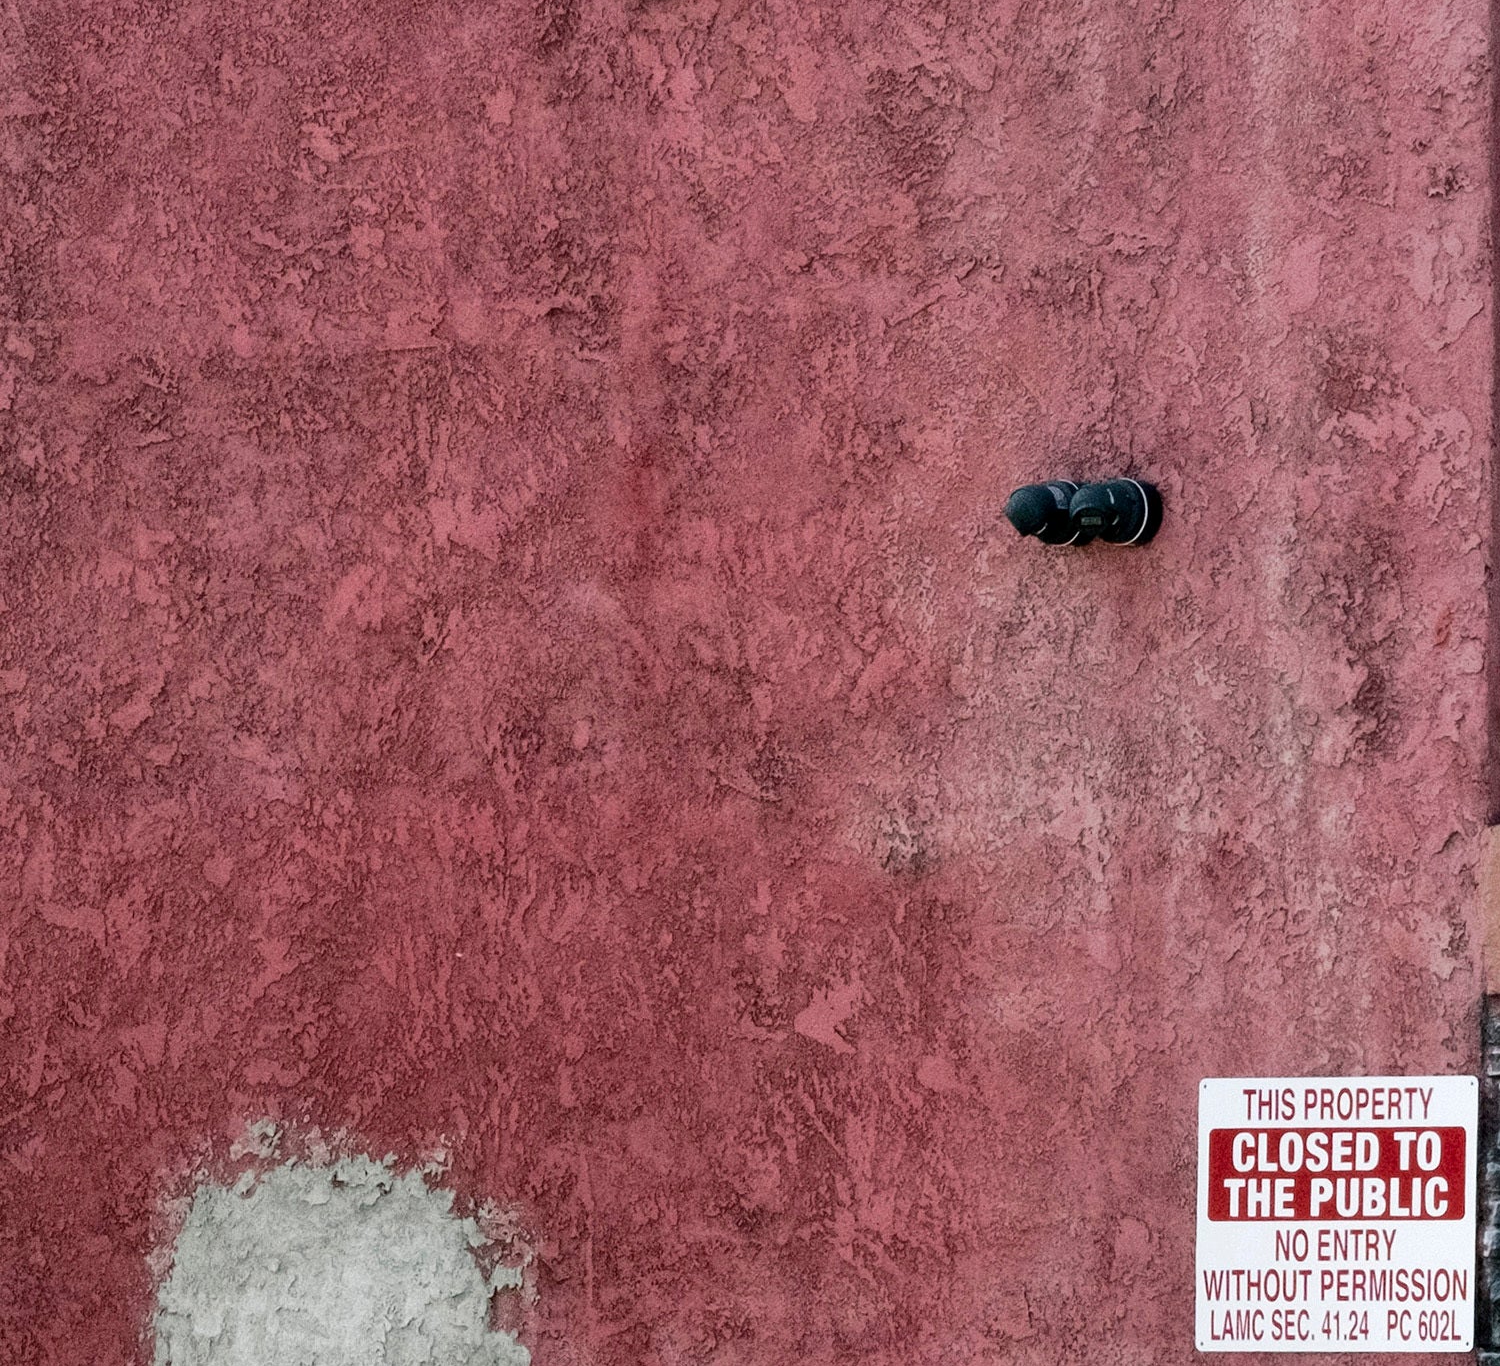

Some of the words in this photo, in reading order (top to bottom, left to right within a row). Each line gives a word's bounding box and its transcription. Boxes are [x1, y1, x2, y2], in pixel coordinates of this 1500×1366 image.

[1243, 1088, 1296, 1121] THIS
[1304, 1087, 1434, 1121] PROPERTY
[1232, 1131, 1380, 1173] CLOSED
[1394, 1131, 1442, 1172] TO
[1223, 1178, 1295, 1218] THE
[1310, 1176, 1449, 1217] PUBLIC
[1275, 1229, 1309, 1262] NO
[1317, 1229, 1397, 1262] ENTRY
[1203, 1269, 1312, 1302] WITHOUT
[1320, 1268, 1467, 1302] PERMISSION
[1210, 1309, 1264, 1341] LAMC
[1271, 1309, 1315, 1341] SEC.
[1321, 1309, 1369, 1341] 41.24
[1387, 1309, 1412, 1341] PC
[1418, 1309, 1462, 1341] 602L
